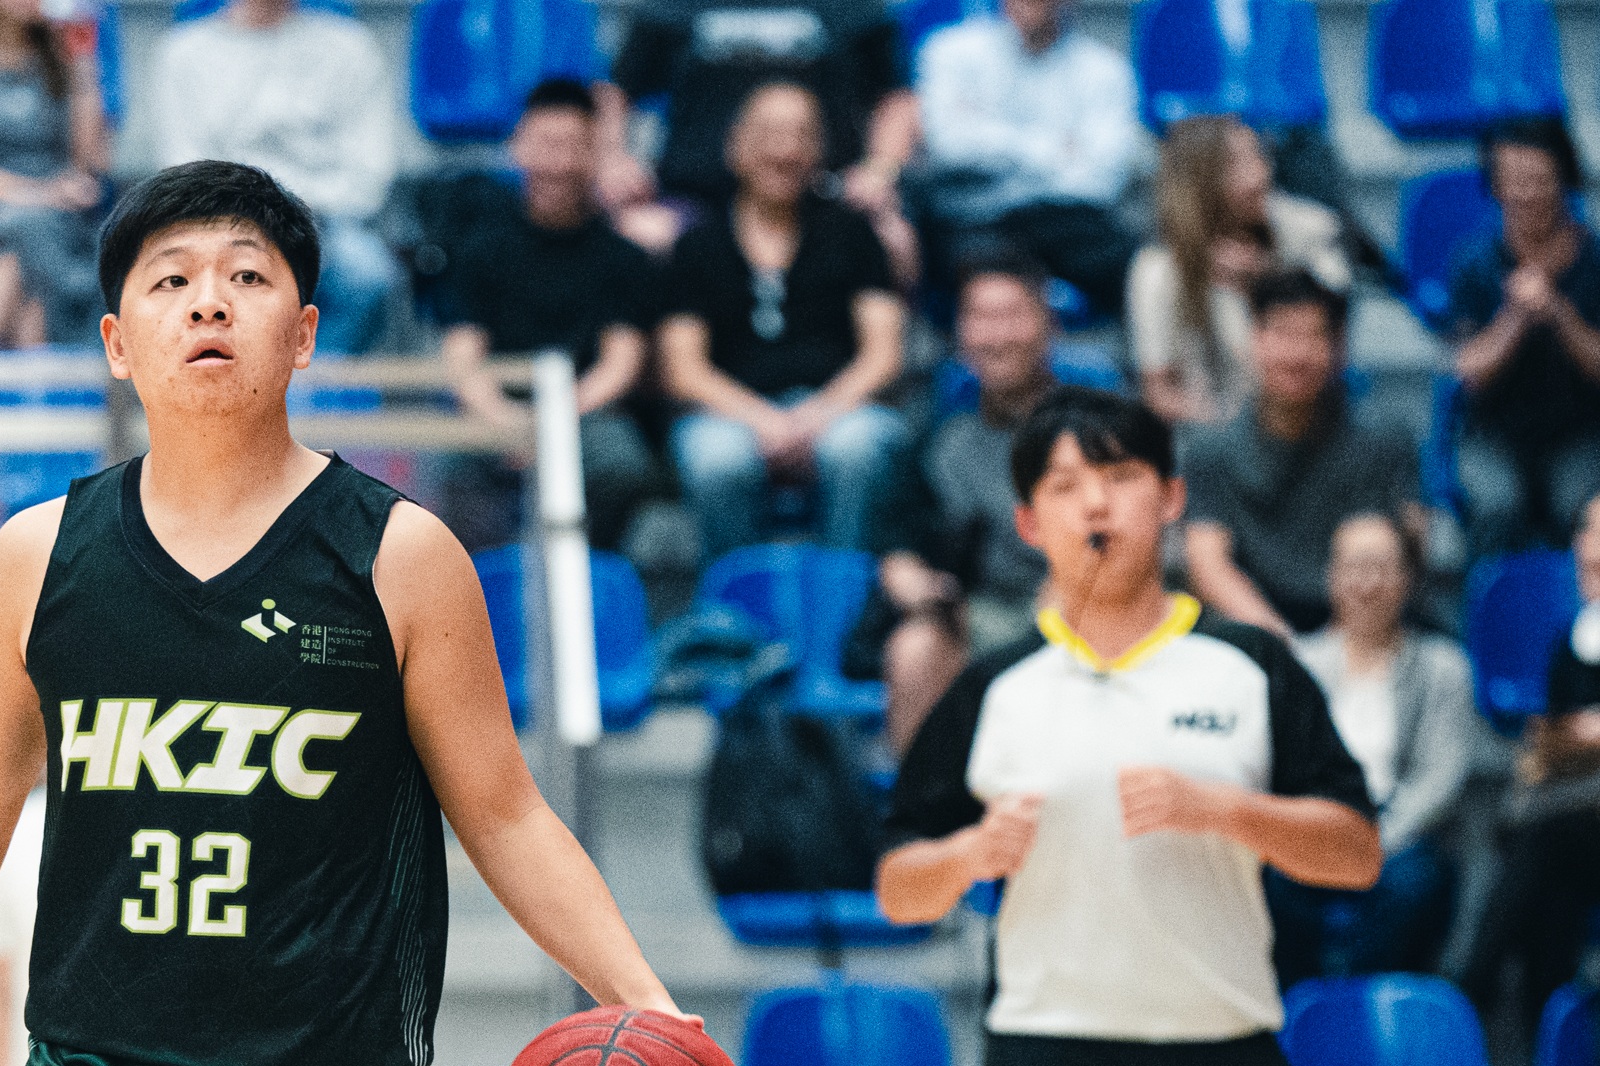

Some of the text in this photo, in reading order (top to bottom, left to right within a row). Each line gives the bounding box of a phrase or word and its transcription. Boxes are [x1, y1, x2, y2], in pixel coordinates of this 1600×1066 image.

[301, 624, 322, 636] 香港
[328, 626, 372, 637] HONG KONG
[300, 638, 322, 650] 建造
[327, 637, 366, 647] INSTITUTE
[327, 647, 337, 655] OF
[300, 652, 322, 664] 學院
[326, 658, 380, 670] CONSTRUCTION
[60, 697, 363, 800] HKIC
[120, 829, 252, 938] 32
